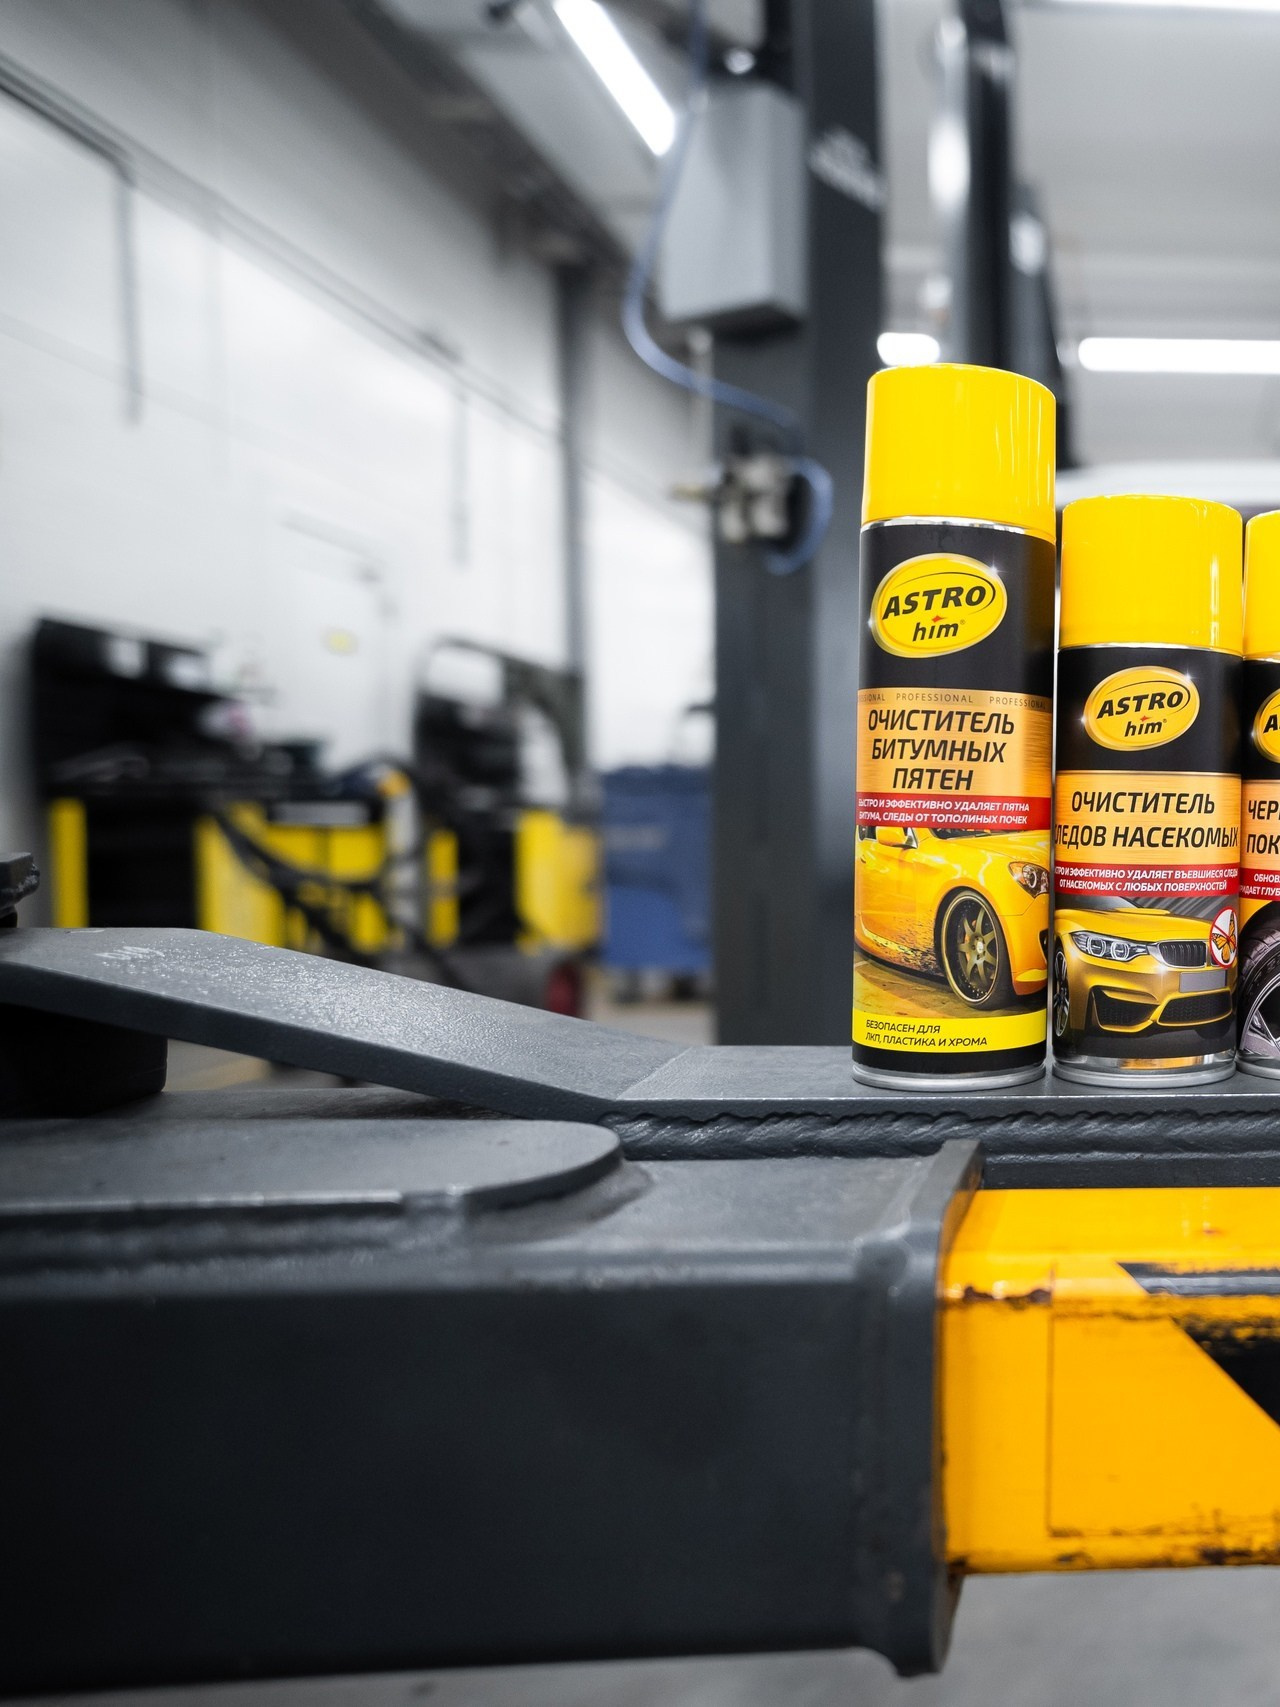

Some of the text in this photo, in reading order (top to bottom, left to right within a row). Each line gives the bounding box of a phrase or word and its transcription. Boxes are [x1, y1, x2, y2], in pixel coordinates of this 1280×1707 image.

[882, 586, 986, 620] ASTRO
[912, 621, 959, 642] him
[896, 692, 973, 703] PROFESSIONAL
[989, 696, 1046, 709] PROFESSIONAL
[1096, 691, 1183, 719] ASTRO
[868, 709, 1015, 735] ОЧИСТИТЕЛЬ
[1124, 720, 1163, 737] him
[872, 738, 1007, 763] БИТУМНЫХ
[892, 767, 974, 791] ПЯТЕН
[879, 799, 885, 808] И
[885, 799, 953, 810] ЭФФЕКТИВНО
[954, 801, 1002, 812] УДАЛЯЕТ
[1002, 803, 1030, 812] ПЯТНА
[1071, 791, 1215, 814] ОЧИСТИТЕЛЬ
[883, 812, 913, 822] СЛЕДЫ
[915, 813, 930, 822] ОТ
[931, 813, 999, 824] ТОПОЛИНЫХ
[999, 815, 1027, 824] ПОЧЕК
[1055, 824, 1238, 850] ЛЕДОВ НАСЕКОМЫХ
[1070, 867, 1126, 878] ЭФФЕКТИВНО
[1127, 870, 1173, 881] УДАЛЯЕТ
[1174, 869, 1223, 879] ВЪЕВШИЕСЯ
[1066, 880, 1114, 891] НАСЕКОМЫХ
[1115, 881, 1122, 890] С
[1123, 881, 1163, 892] ЛЮБЫХ
[1163, 879, 1227, 892] ПОВЕРХНОСТЕЙ
[866, 1019, 941, 1034] БЕЗОПАСЕН ДЛЯ
[865, 1032, 988, 1047] ЛКП, ПЛАСТИКА И ХРОМА
